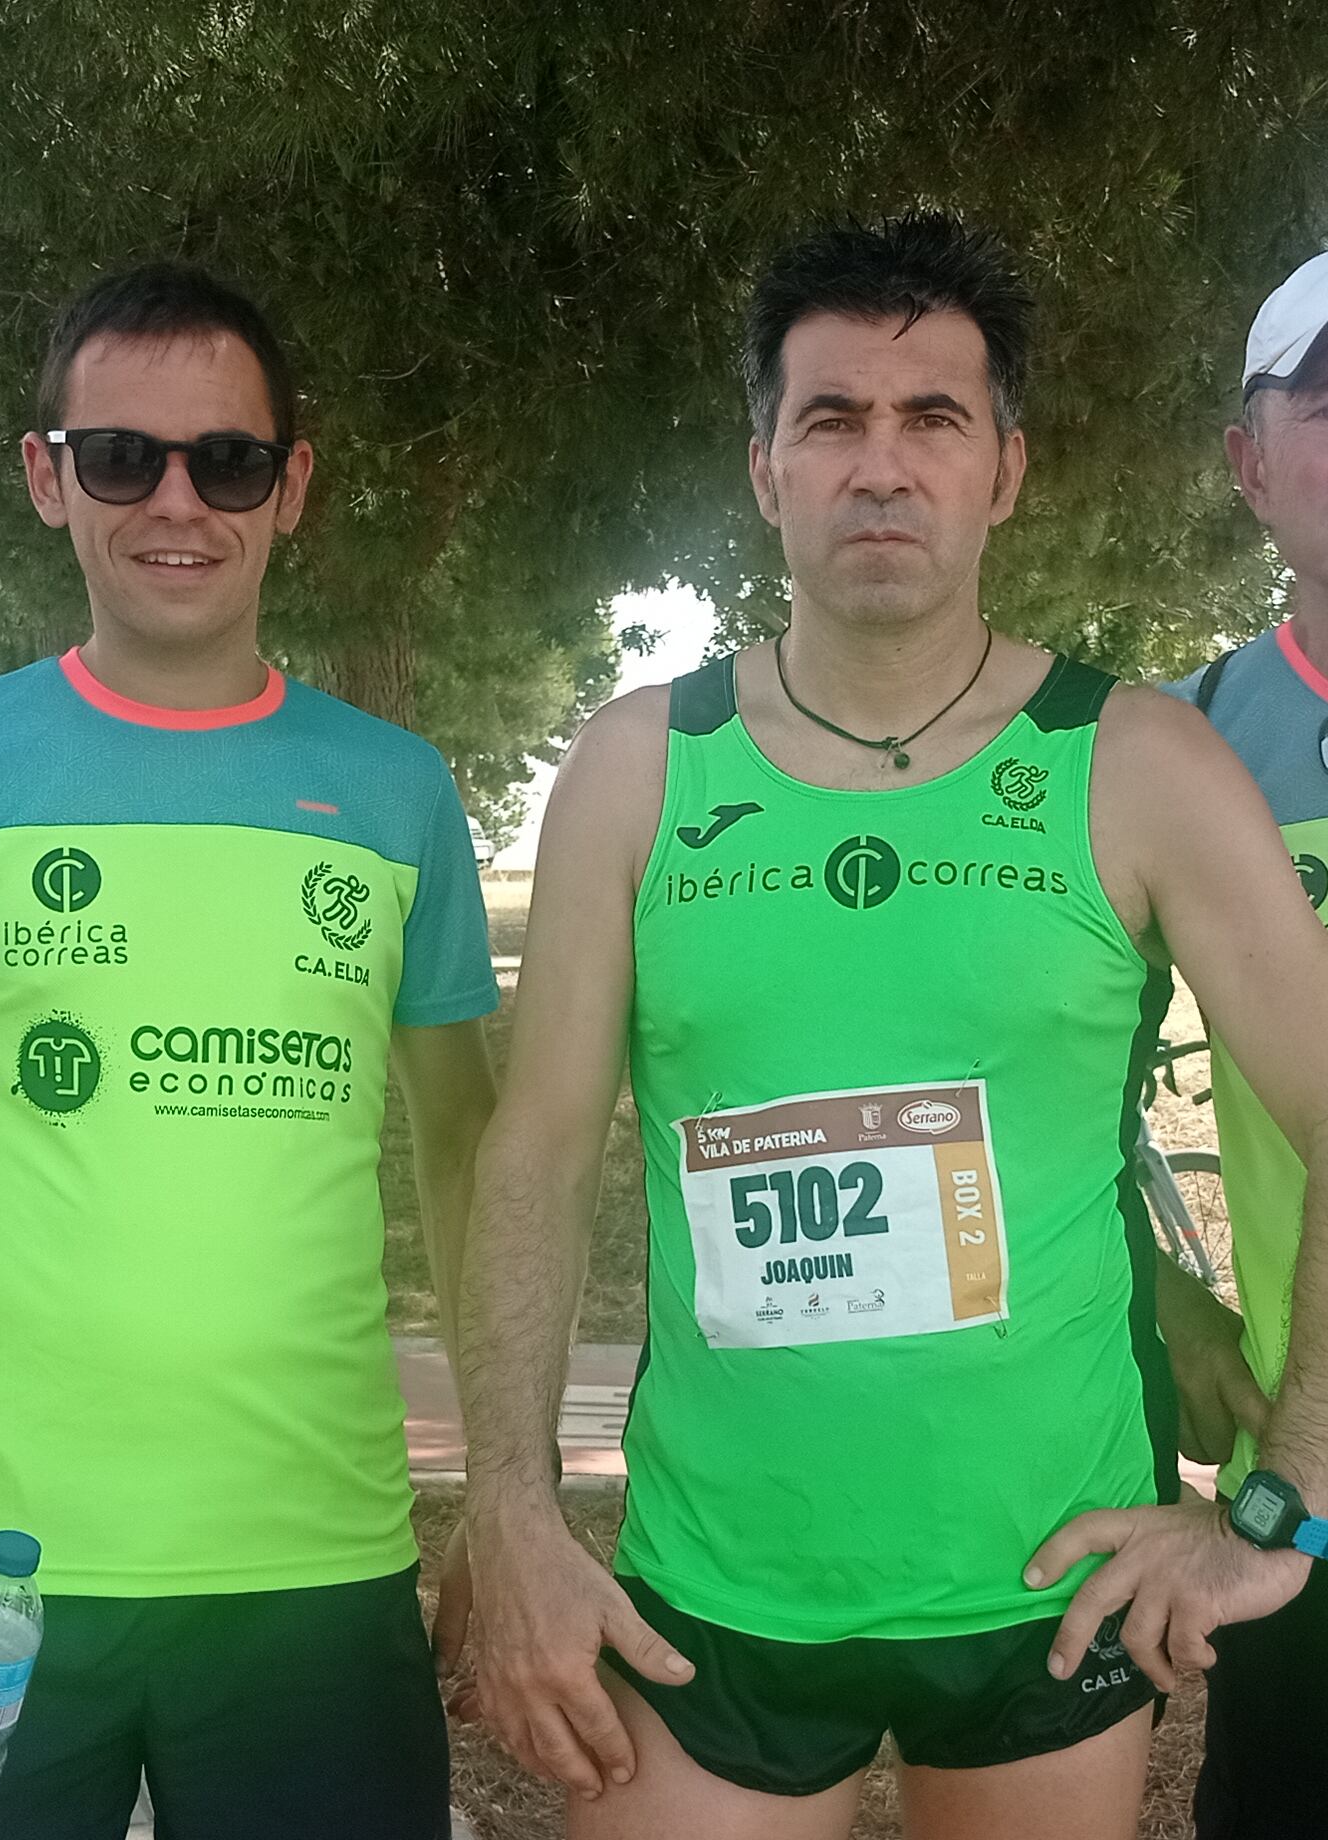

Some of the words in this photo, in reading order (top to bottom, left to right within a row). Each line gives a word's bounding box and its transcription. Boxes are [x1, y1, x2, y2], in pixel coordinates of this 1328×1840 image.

[667, 862, 814, 906] ibérica
[908, 860, 1068, 895] correas
[4, 920, 128, 946] ibérica
[4, 945, 128, 967] correas
[129, 1071, 352, 1103] económicas
[906, 1110, 954, 1125] Serrano
[699, 1141, 731, 1159] VILA
[732, 1139, 751, 1155] DE
[753, 1128, 827, 1152] PATERNA
[707, 1127, 731, 1141] KM
[730, 1161, 889, 1249] 5102
[952, 1169, 983, 1221] BOX
[959, 1229, 986, 1247] 2
[761, 1253, 853, 1285] JOAQUIN
